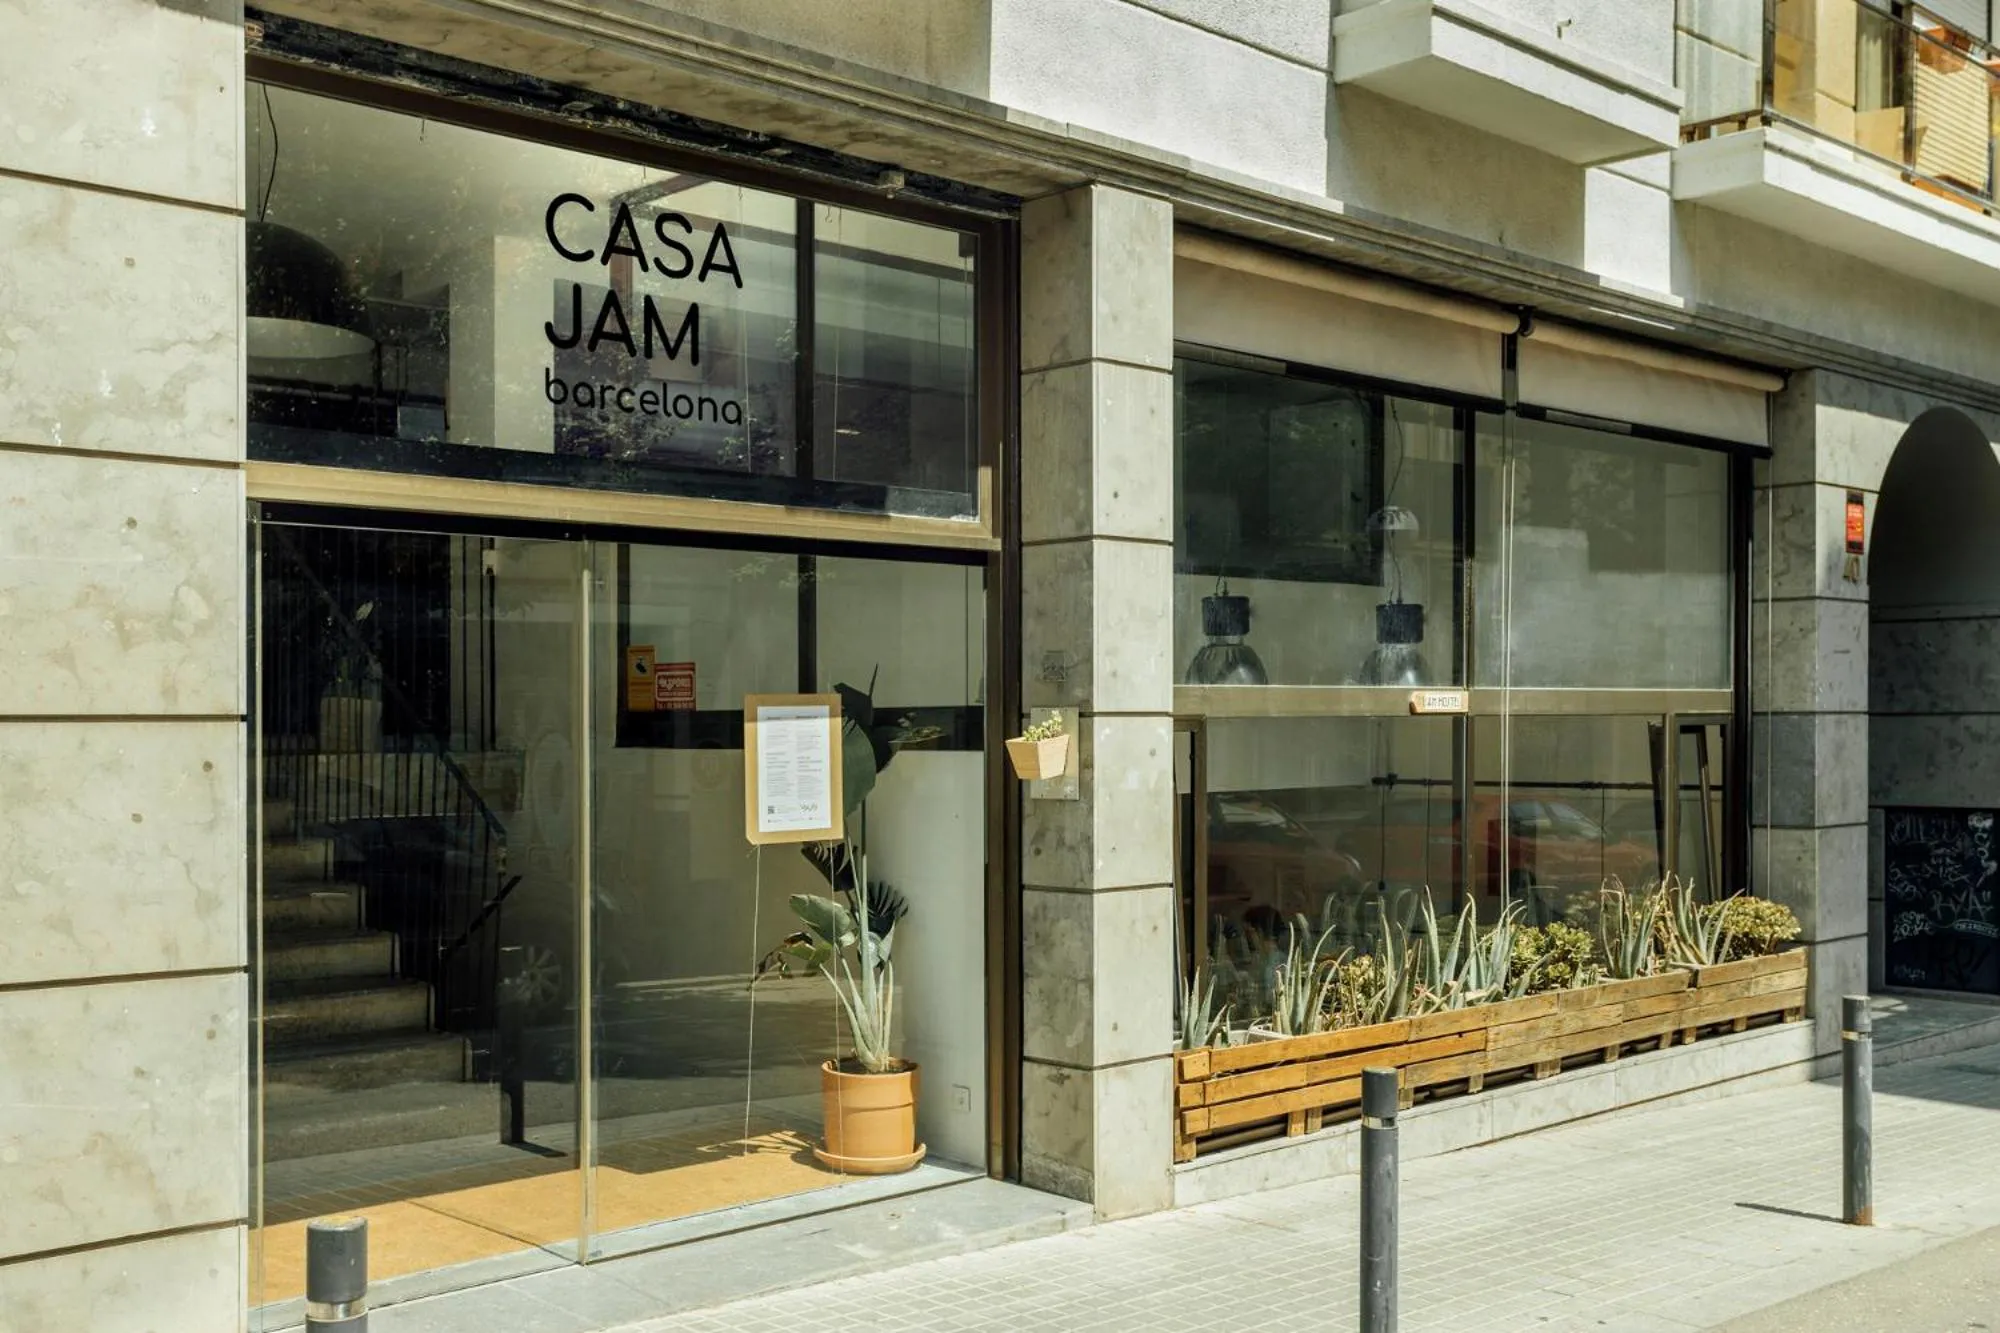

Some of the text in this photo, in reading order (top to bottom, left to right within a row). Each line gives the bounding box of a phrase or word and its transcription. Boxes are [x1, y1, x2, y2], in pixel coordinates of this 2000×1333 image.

[545, 193, 743, 288] CASA
[545, 283, 700, 366] JAM
[545, 367, 742, 426] barcelona
